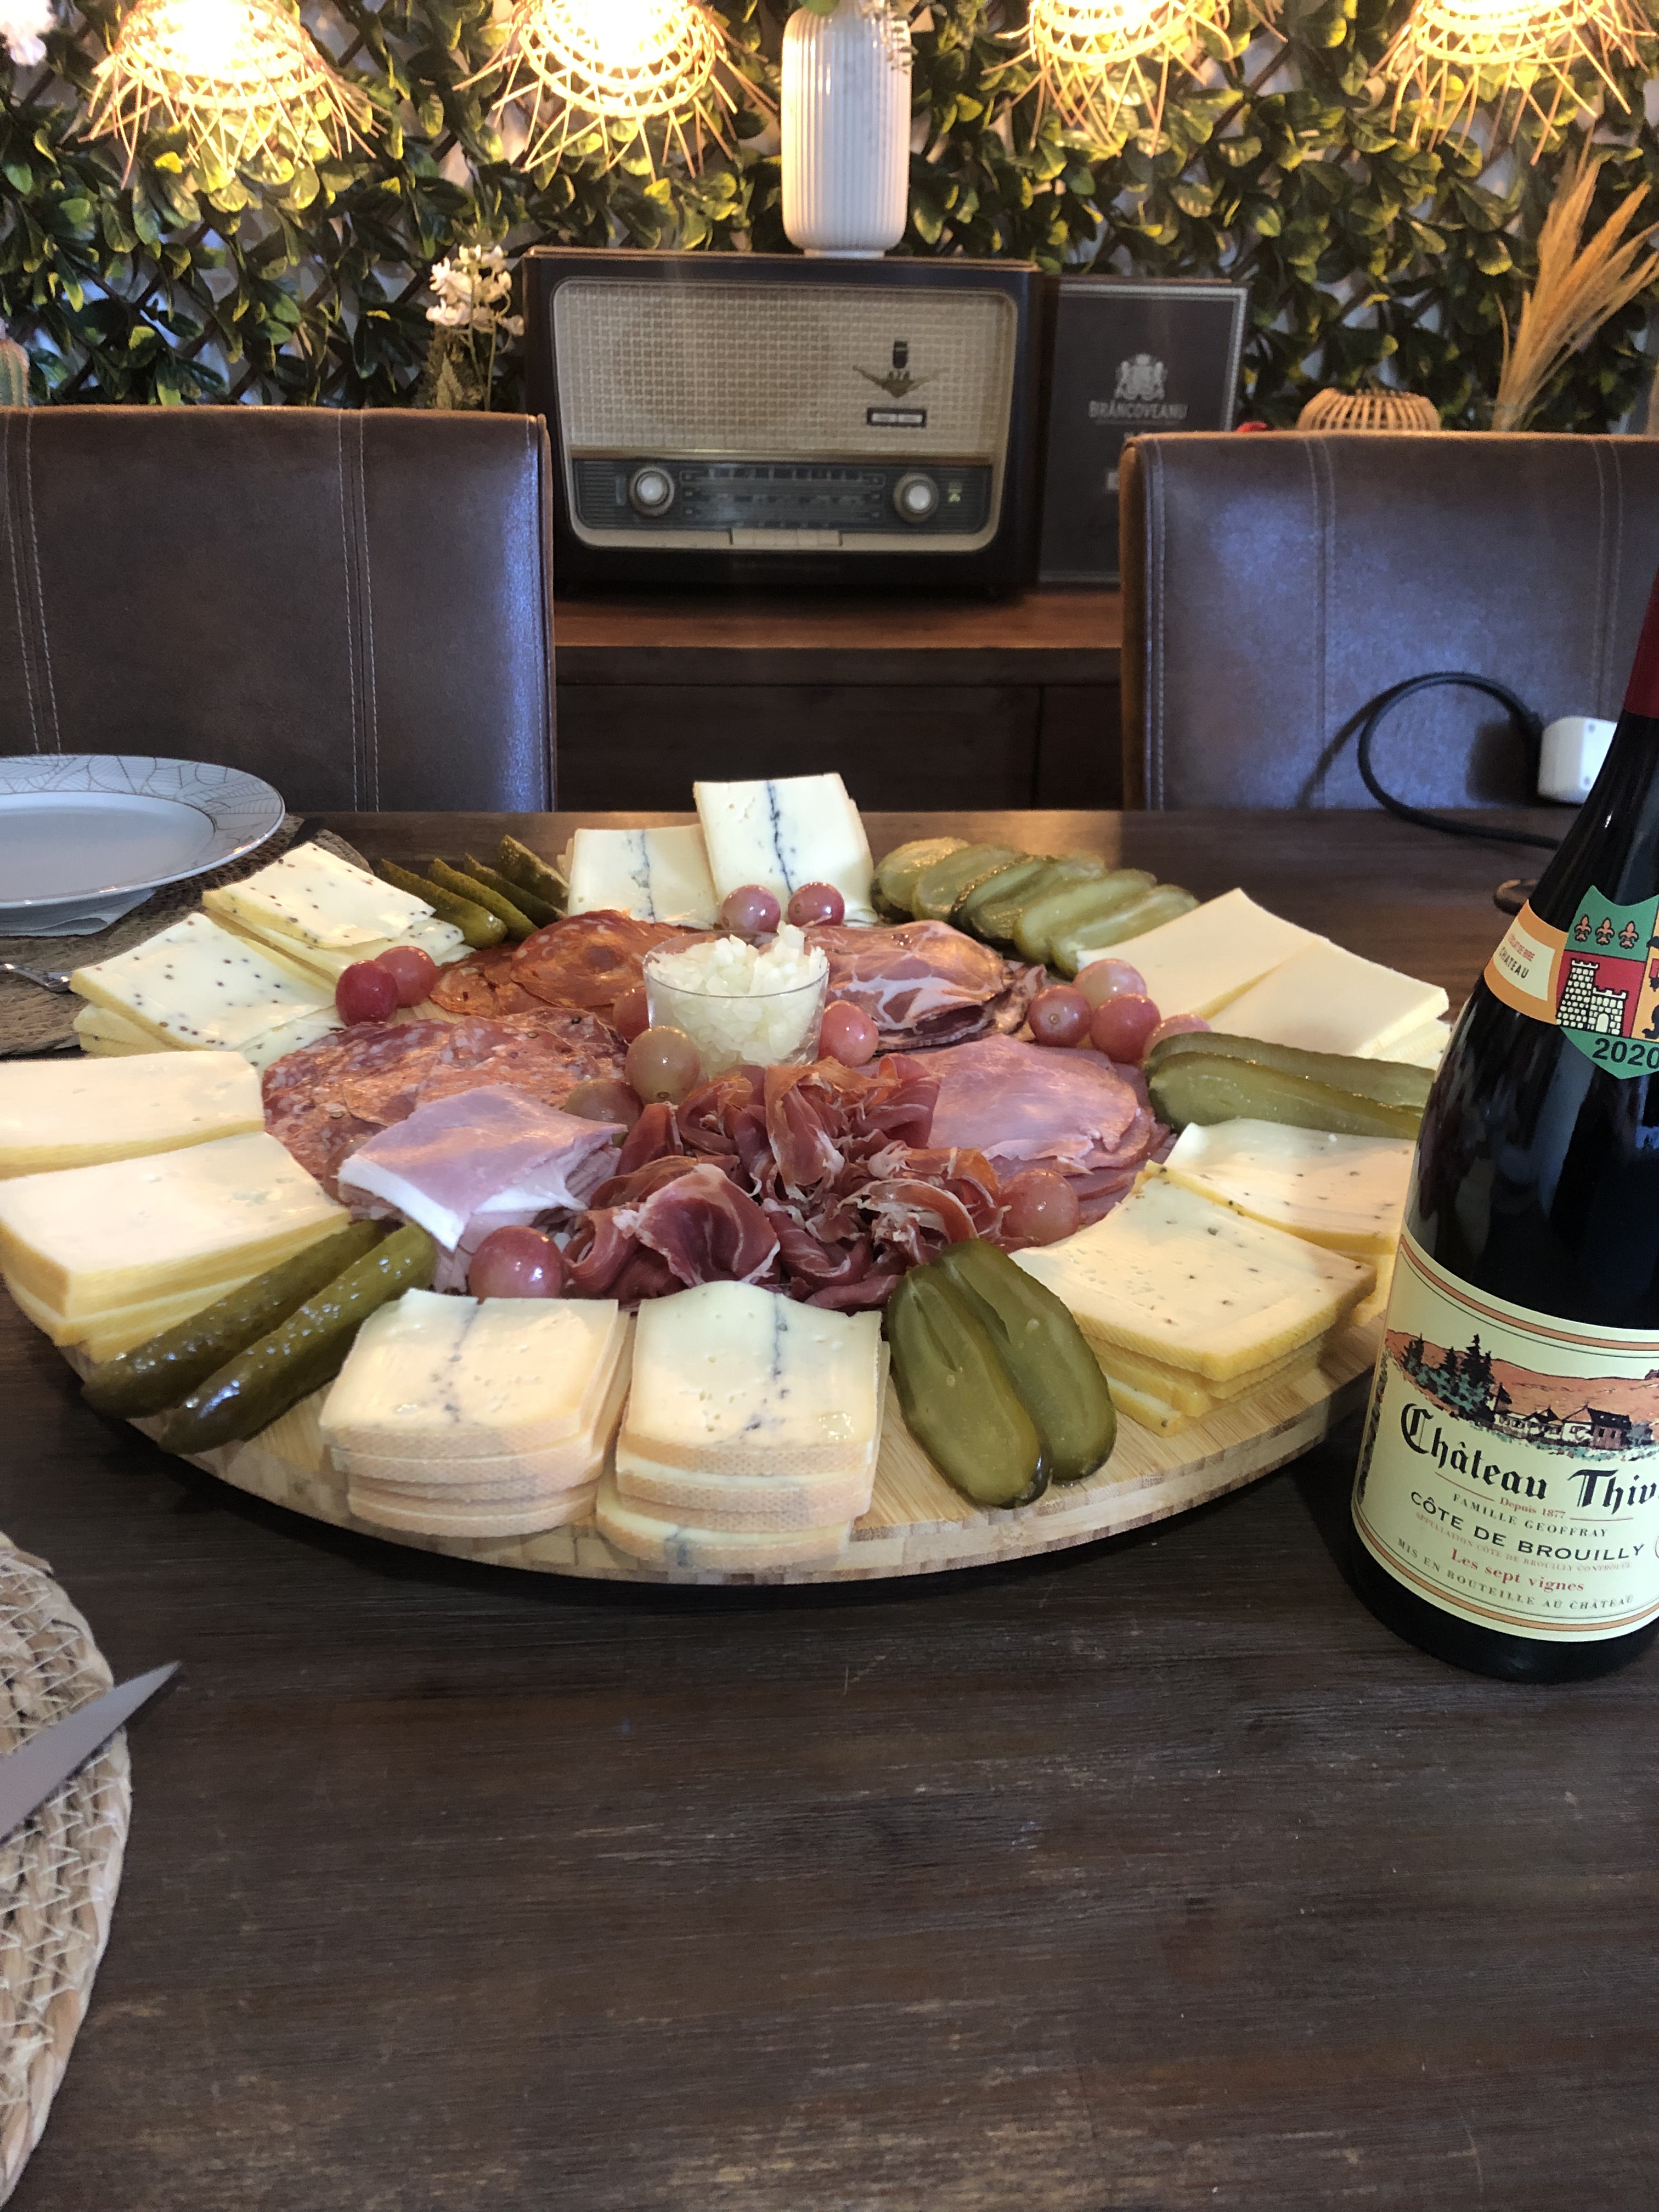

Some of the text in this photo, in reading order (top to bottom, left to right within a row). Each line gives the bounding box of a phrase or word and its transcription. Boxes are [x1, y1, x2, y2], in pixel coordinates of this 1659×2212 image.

[1592, 1037, 1659, 1069] 2020
[1401, 1403, 1659, 1515] Château Thiv
[1410, 1491, 1645, 1561] CÔTE DE BROUILLY
[1453, 1493, 1608, 1537] FAMILLE GEOFFRAY
[1500, 1497, 1566, 1519] Depuis 1877
[1415, 1511, 1473, 1548] APPELLATION
[1506, 1553, 1519, 1562] DE
[1397, 1537, 1418, 1558] MIS
[1424, 1556, 1441, 1572] EN
[1447, 1570, 1535, 1606] BOUTEILLE
[1543, 1599, 1562, 1609] AU
[1451, 1547, 1584, 1593] Les sept vignes
